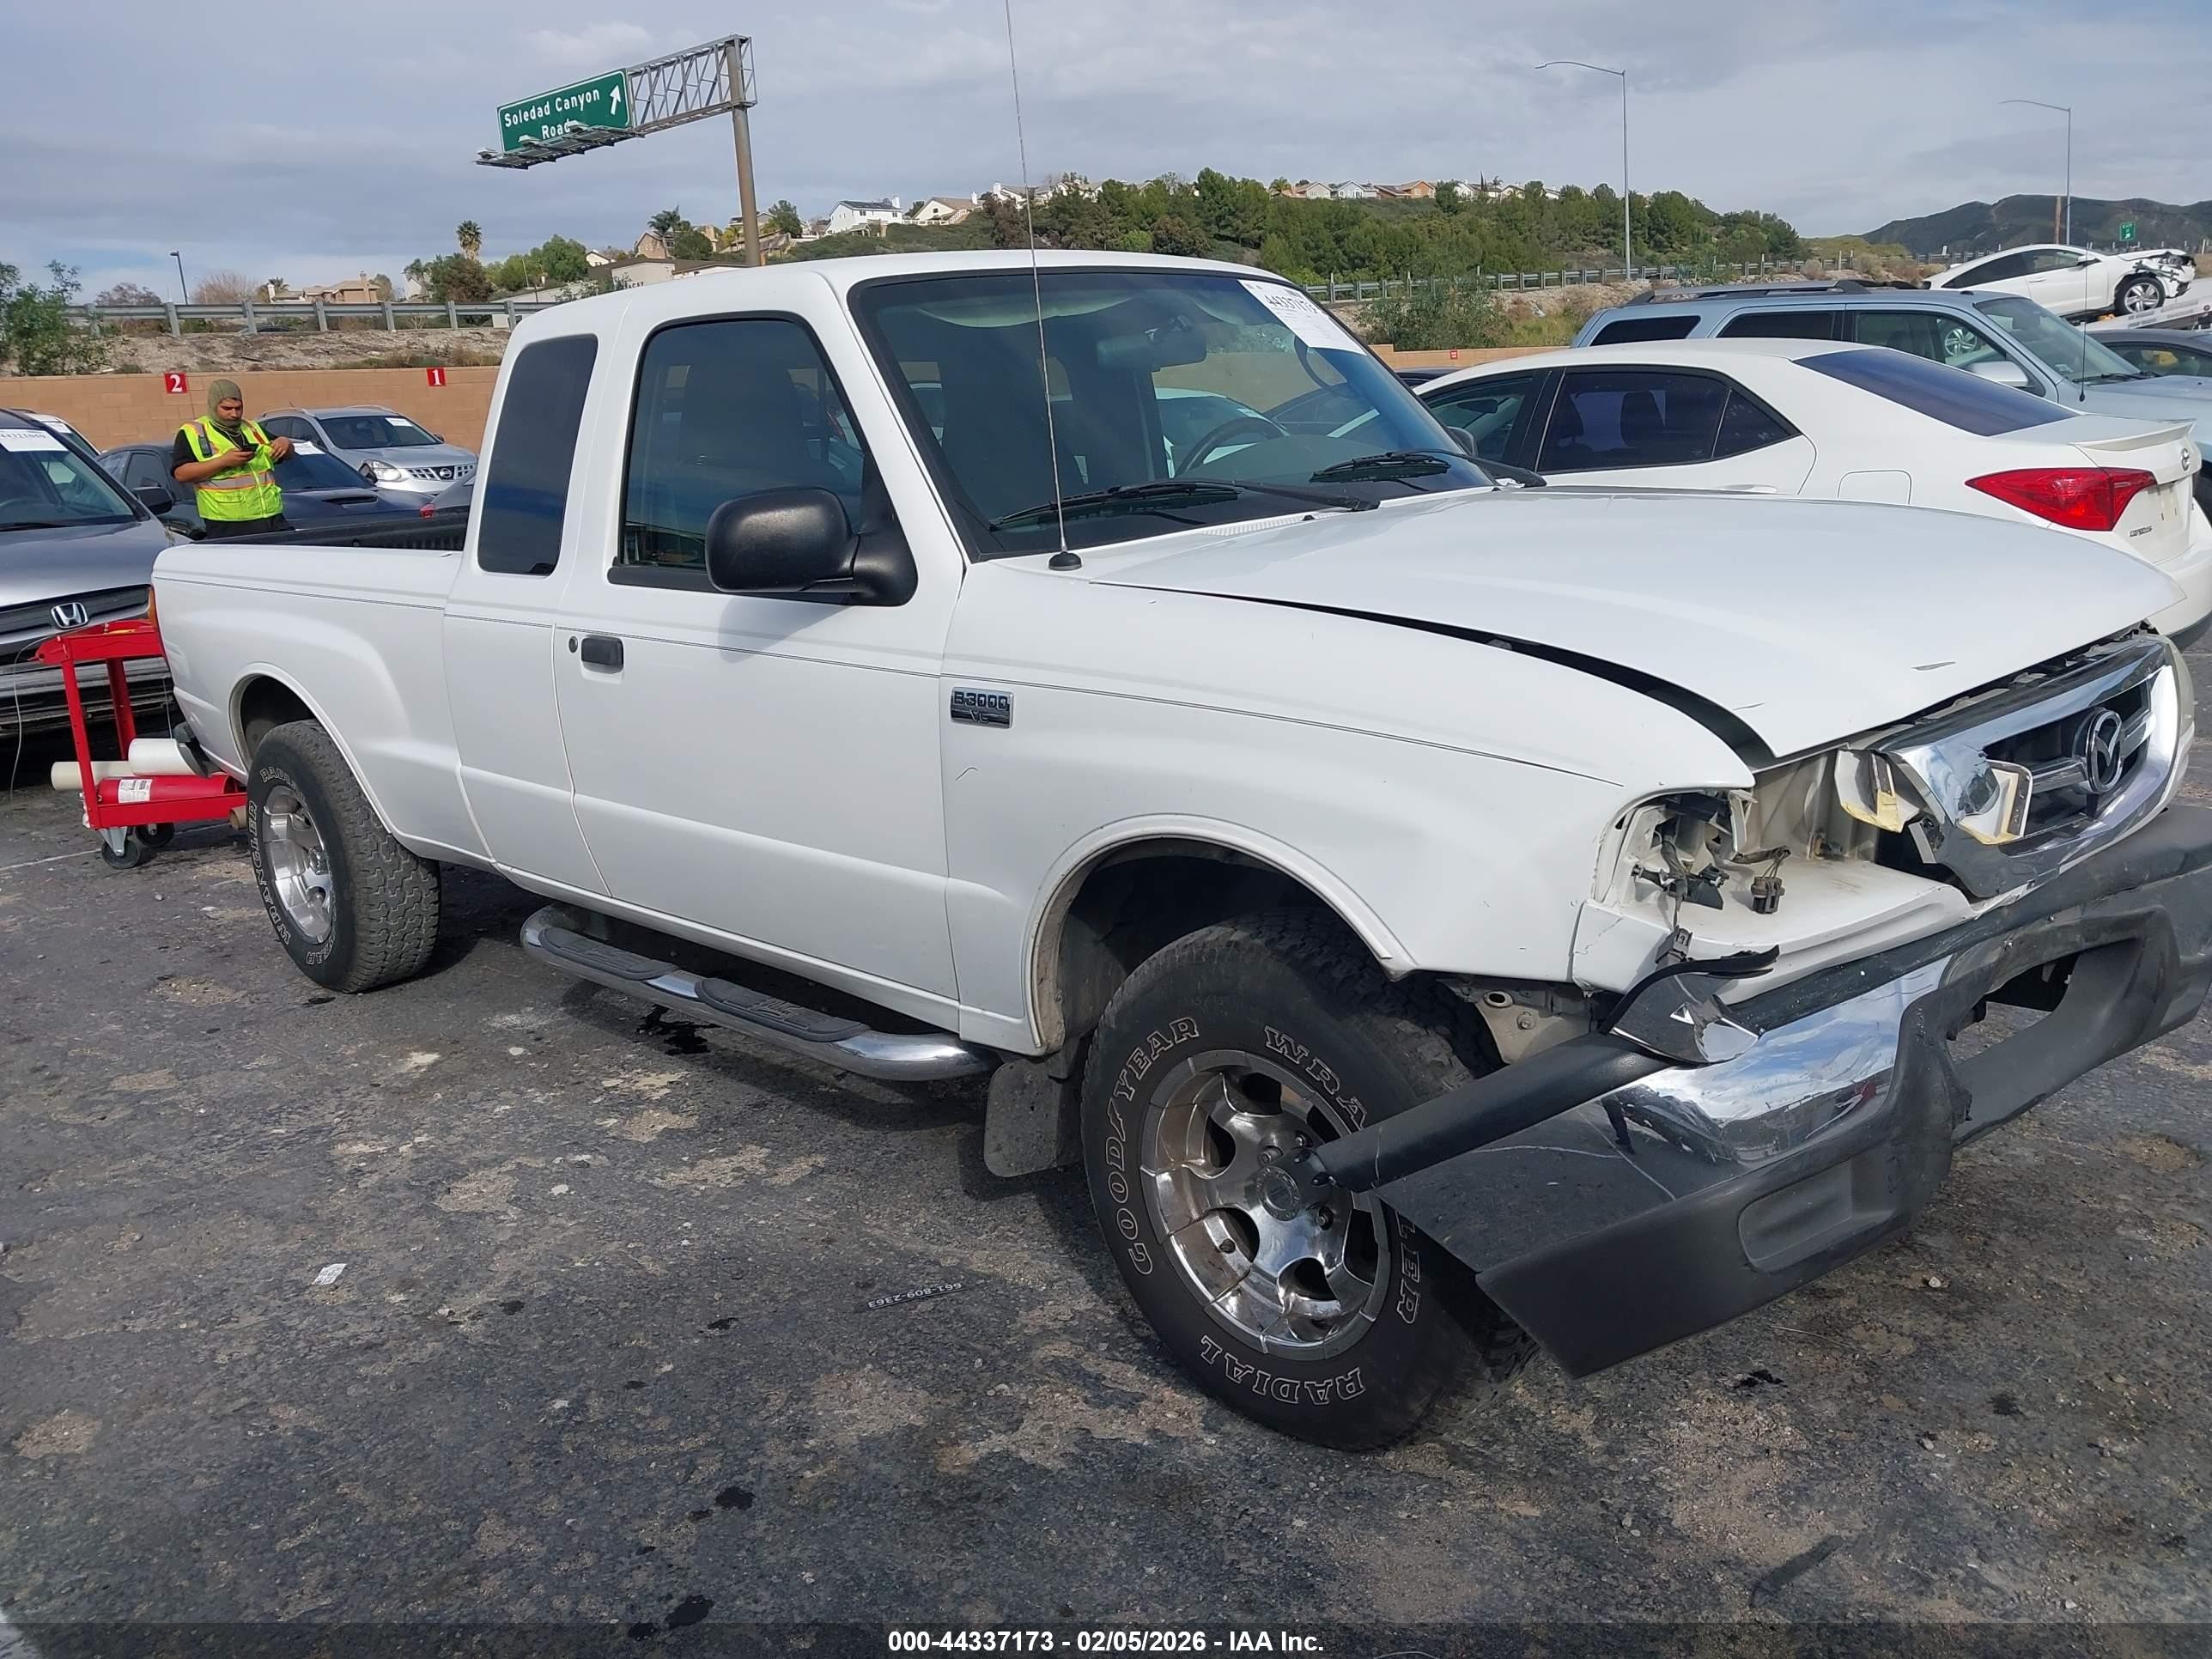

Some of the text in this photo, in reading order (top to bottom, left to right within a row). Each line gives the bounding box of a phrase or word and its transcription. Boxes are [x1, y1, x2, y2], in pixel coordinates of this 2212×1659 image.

[504, 88, 600, 128] Soledad Canyon
[541, 119, 571, 141] Road
[170, 374, 183, 392] 2
[432, 369, 442, 386] 1
[954, 690, 1009, 711] B3000
[248, 799, 291, 945] WRANGLER
[1105, 1017, 1200, 1276] GOODYEAR
[867, 1282, 963, 1308] 661-809-2363
[1200, 1334, 1367, 1407] RADIAL
